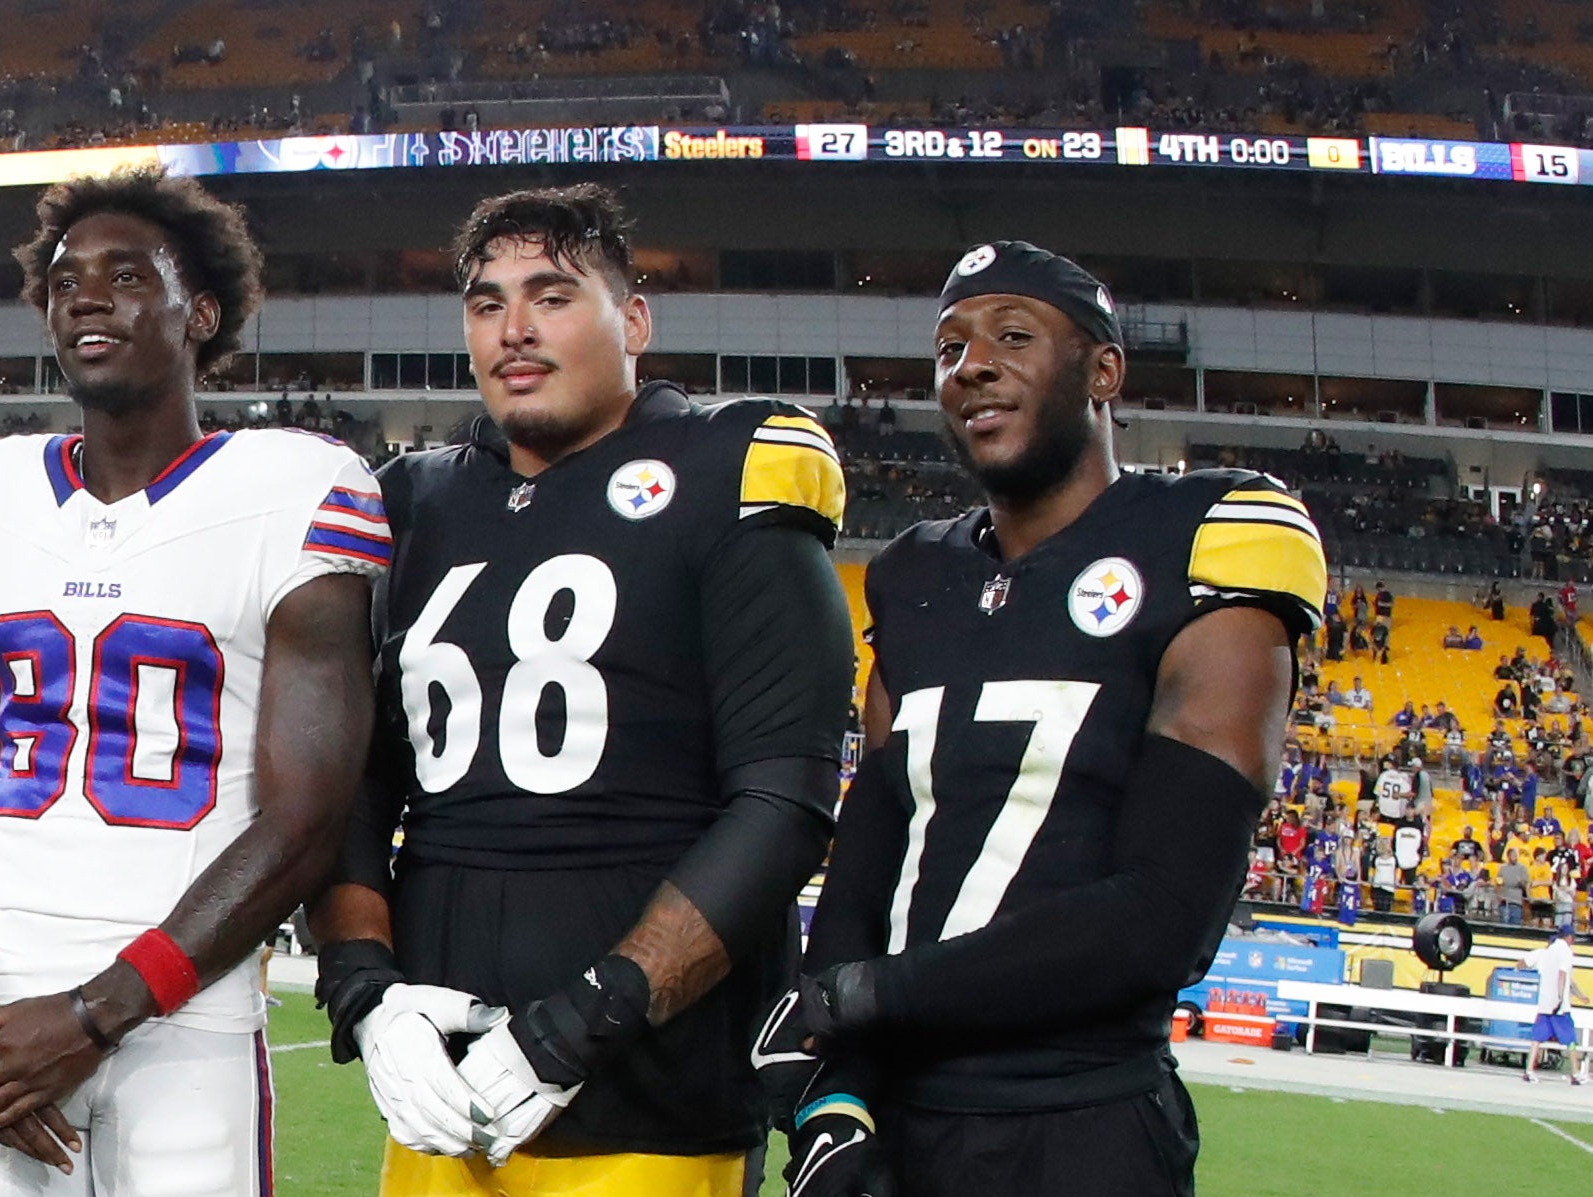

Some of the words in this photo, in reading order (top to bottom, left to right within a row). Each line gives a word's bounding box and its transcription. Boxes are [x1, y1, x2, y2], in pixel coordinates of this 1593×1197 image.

[664, 130, 764, 159] Steelers
[821, 133, 856, 154] 27
[884, 131, 945, 157] 3RD
[968, 131, 1003, 157] 12
[1024, 139, 1057, 158] ON
[1063, 132, 1101, 158] 23
[1159, 135, 1219, 163] 4TH
[1230, 138, 1289, 165] 0:00
[1328, 145, 1340, 163] 0
[1379, 142, 1477, 175] BILLS
[1536, 154, 1568, 177] 15
[62, 581, 122, 598] BILLS
[399, 554, 618, 794] 68
[887, 680, 1103, 956] 17
[1213, 1024, 1264, 1038] GATORADE
